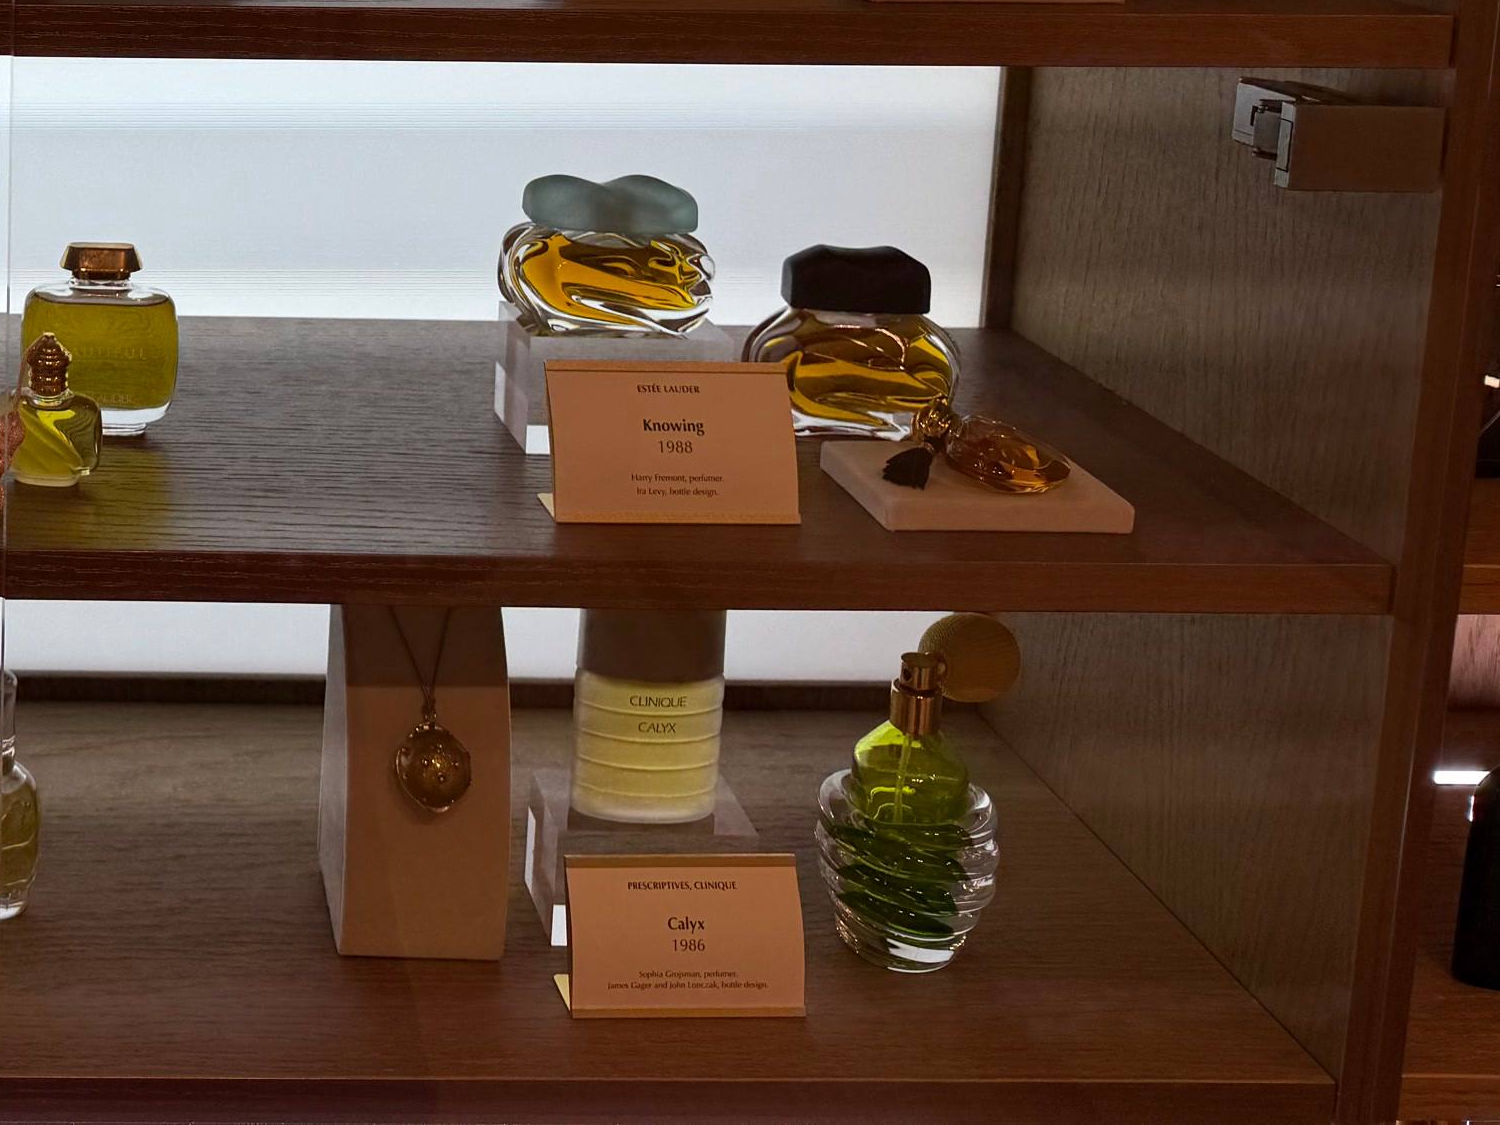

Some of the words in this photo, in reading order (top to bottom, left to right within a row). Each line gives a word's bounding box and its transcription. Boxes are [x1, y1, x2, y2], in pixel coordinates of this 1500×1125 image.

[637, 384, 661, 393] ESTÉE
[664, 385, 700, 394] LAUDER
[643, 419, 704, 436] Knowing
[659, 441, 693, 453] 1988
[631, 474, 652, 483] Harry
[669, 488, 691, 496] bottle
[629, 694, 688, 709] CLINIQUE
[637, 721, 677, 735] CALYX
[628, 881, 692, 890] PRESCRIPTIVES,
[694, 881, 736, 891] CLINIQUE
[668, 917, 704, 933] Calyx
[673, 939, 705, 951] 1986
